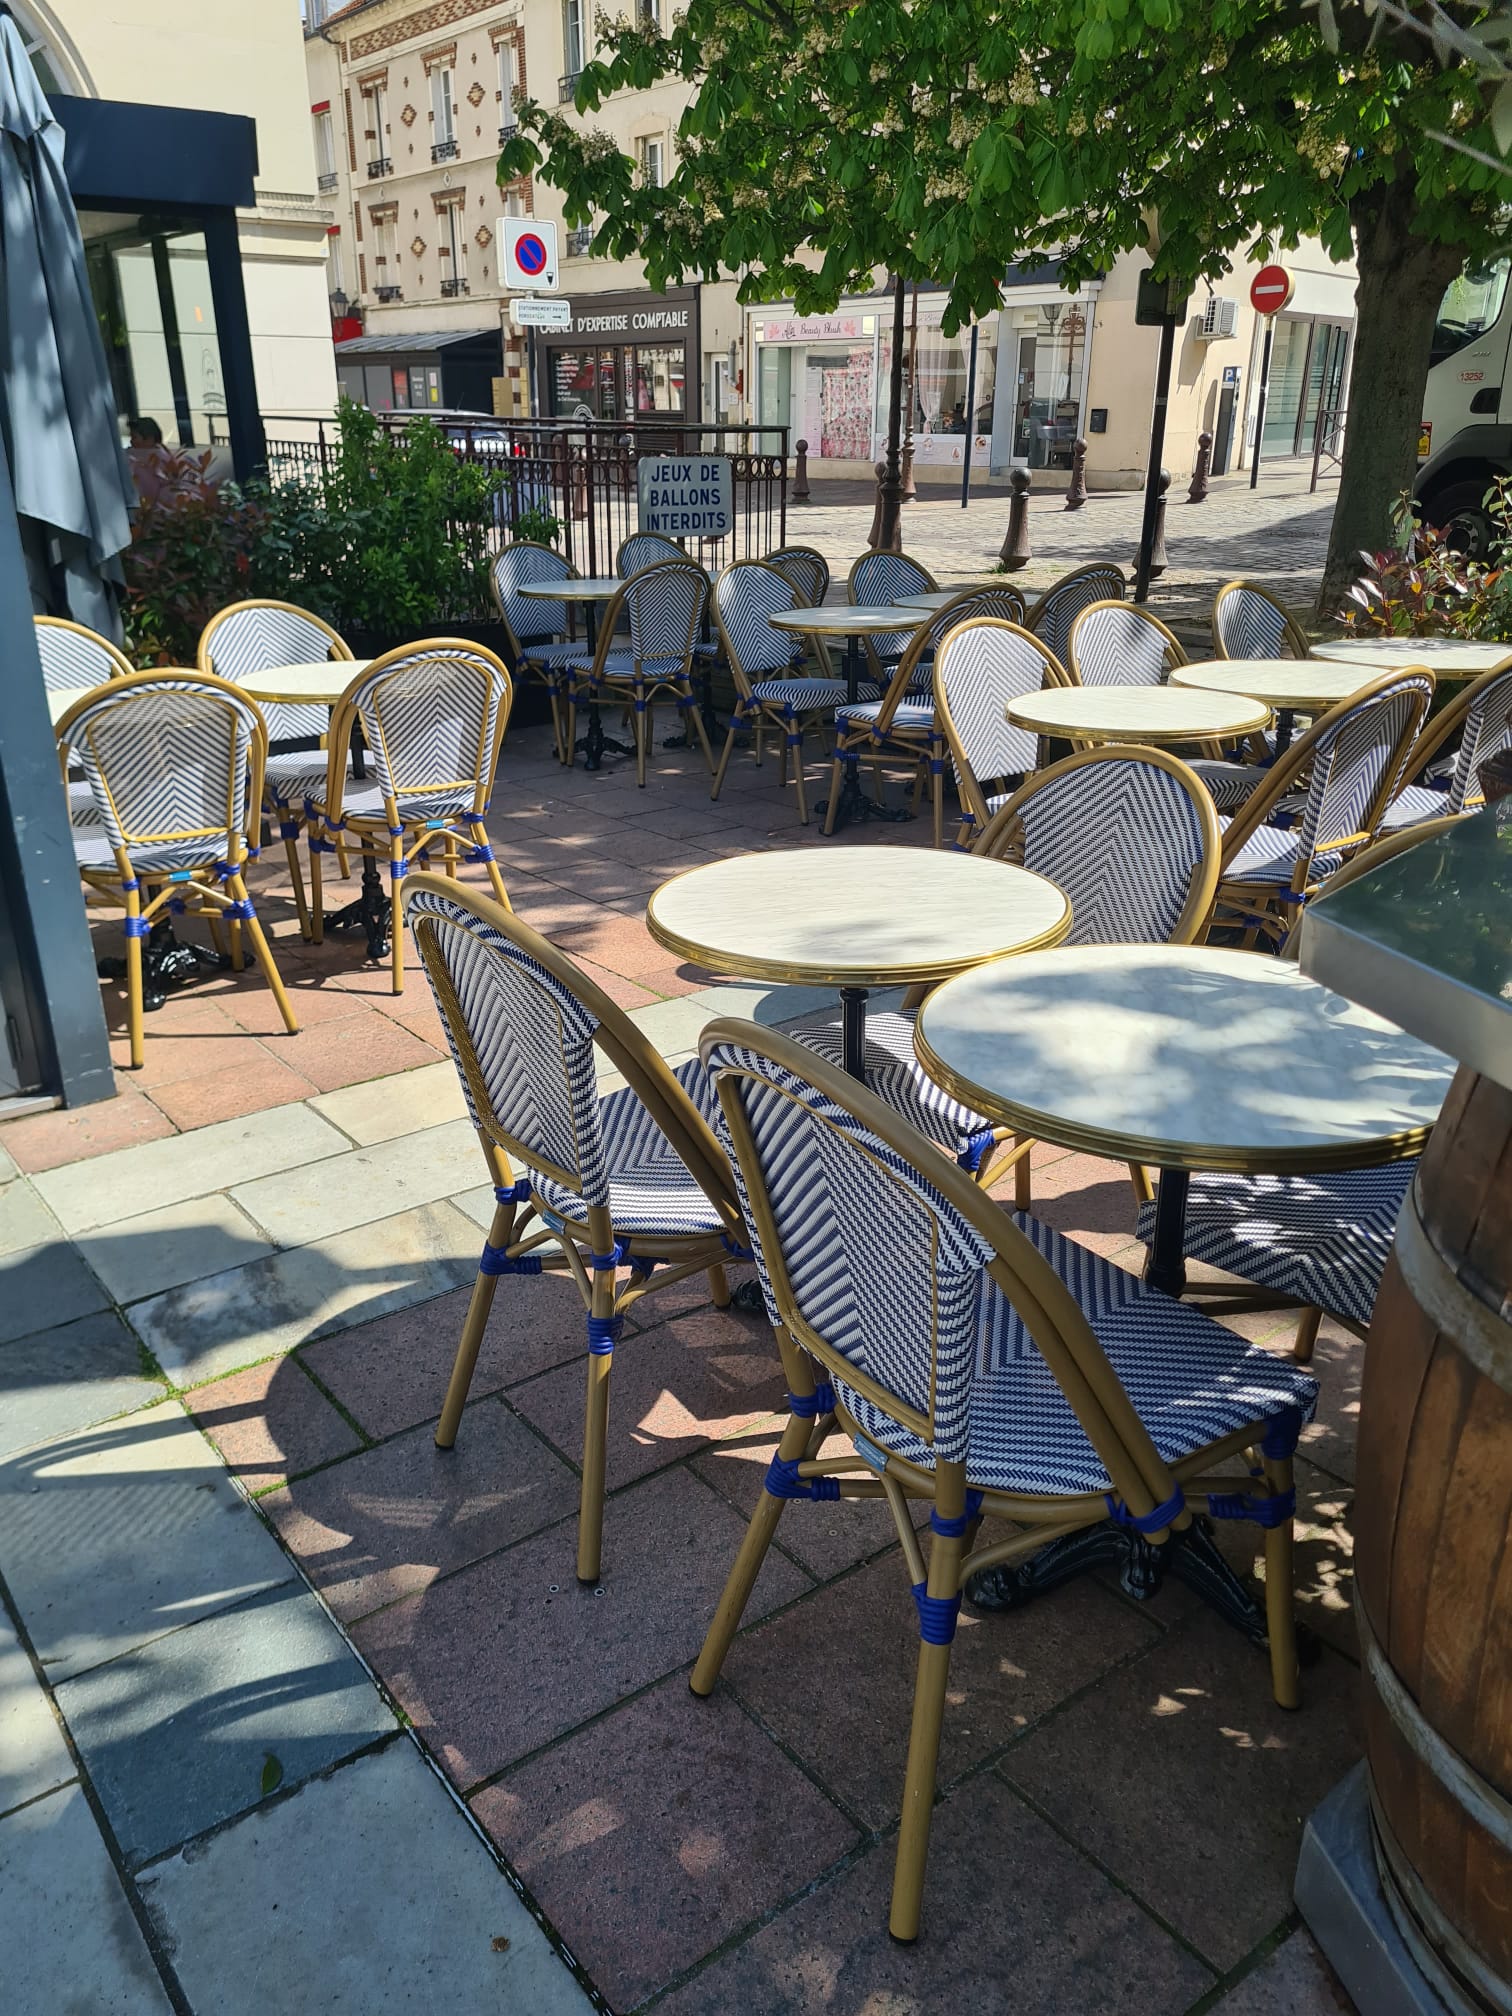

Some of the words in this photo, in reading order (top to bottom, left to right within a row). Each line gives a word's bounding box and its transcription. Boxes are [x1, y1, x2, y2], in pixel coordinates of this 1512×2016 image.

[577, 314, 628, 332] D'EXPERTISE
[632, 310, 688, 329] COMPTABLE
[800, 322, 821, 338] Beauty
[1225, 369, 1234, 382] P
[651, 464, 692, 482] JEUX
[700, 464, 720, 482] DE
[650, 488, 721, 507] BALLONS
[646, 511, 726, 531] INTERDITS
